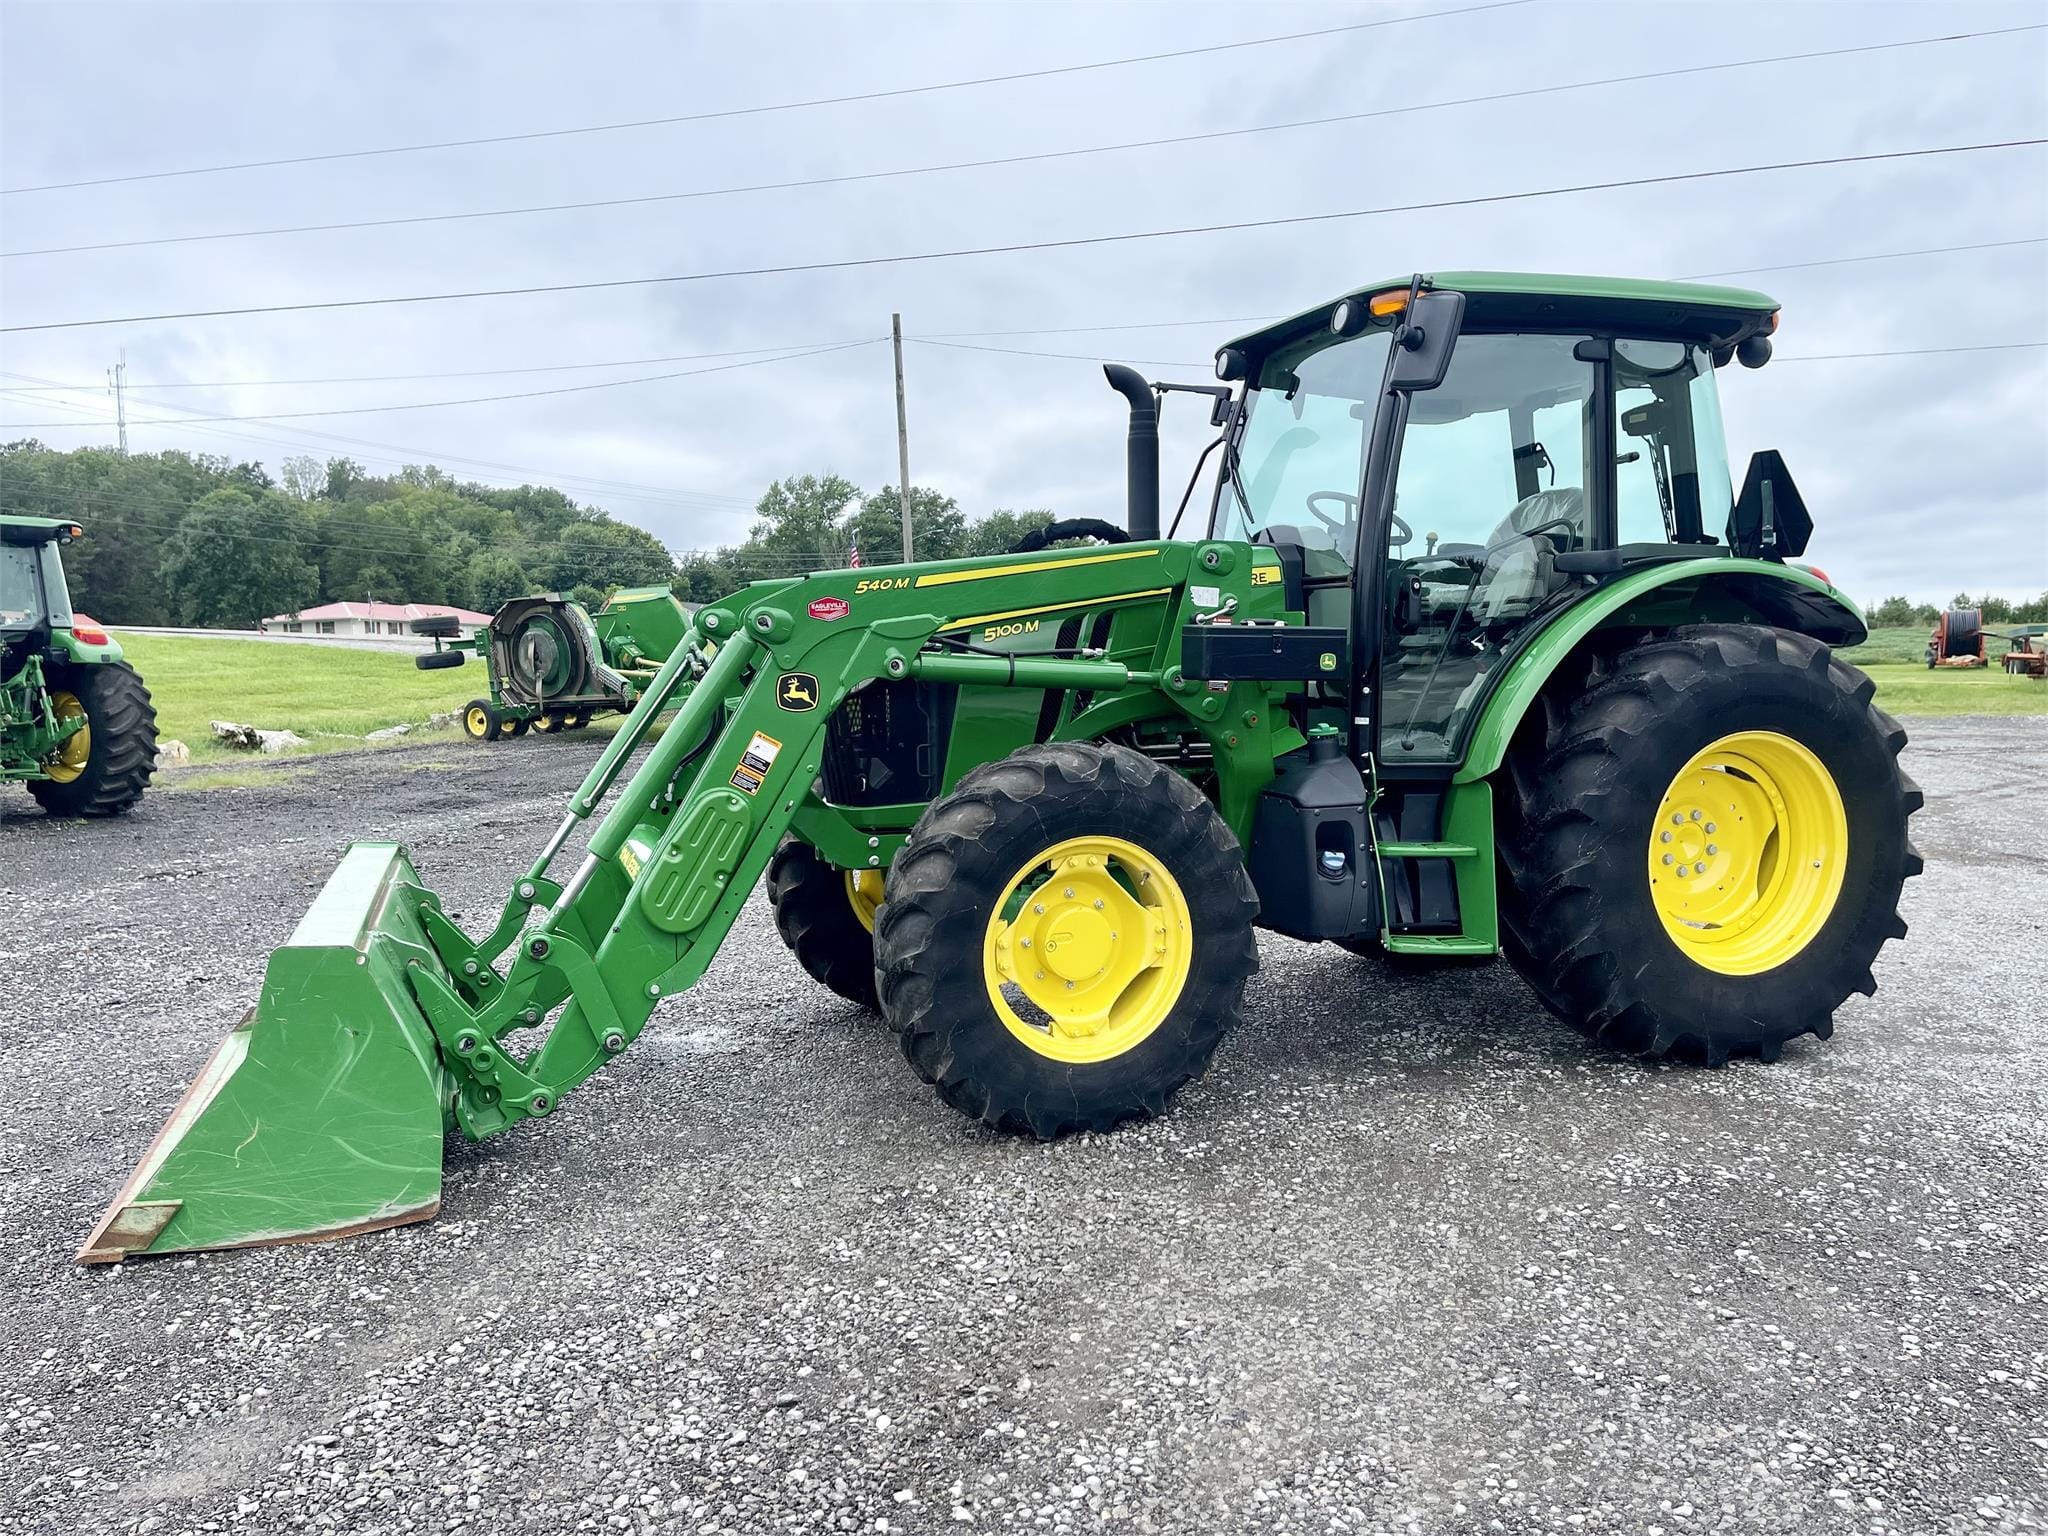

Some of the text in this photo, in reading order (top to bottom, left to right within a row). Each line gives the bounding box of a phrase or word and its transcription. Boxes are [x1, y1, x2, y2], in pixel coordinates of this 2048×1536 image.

[854, 577, 910, 594] 540 M
[983, 619, 1040, 642] 5100 M
